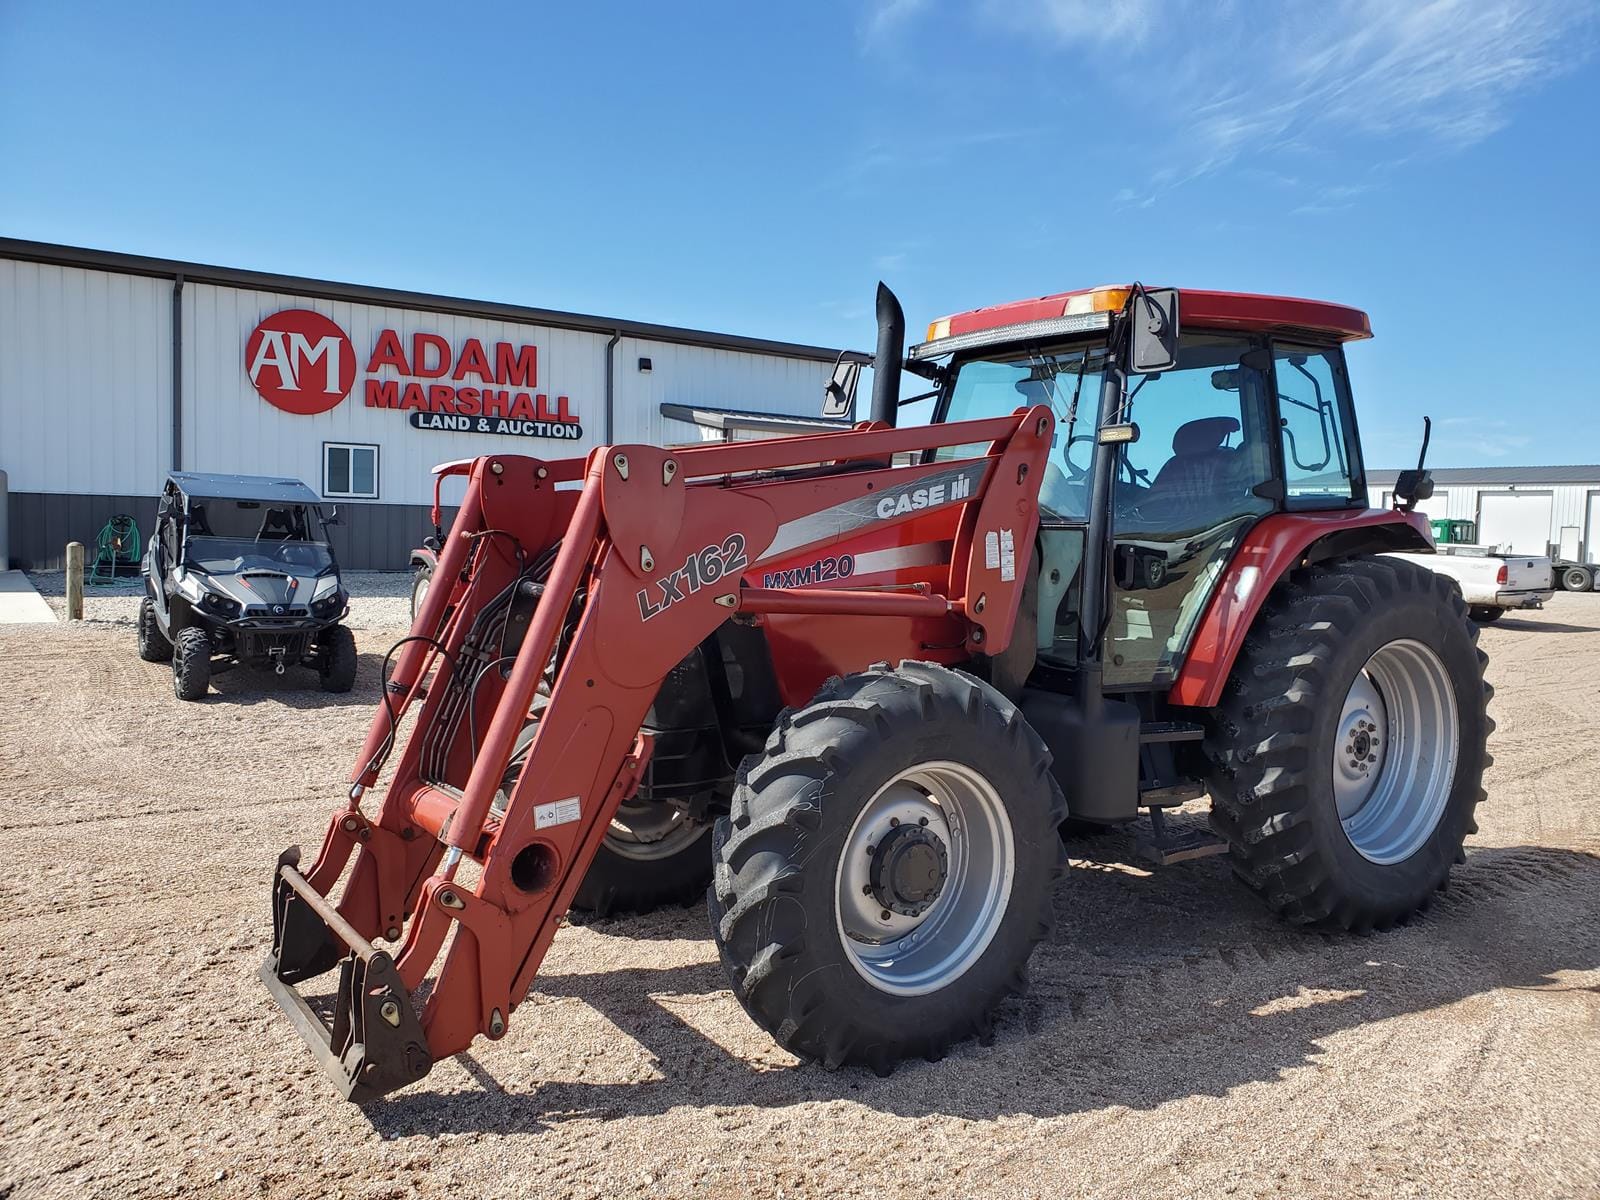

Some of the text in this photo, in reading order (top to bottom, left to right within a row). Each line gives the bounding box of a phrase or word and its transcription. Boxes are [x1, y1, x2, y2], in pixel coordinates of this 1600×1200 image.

[250, 329, 343, 395] AM
[366, 329, 538, 388] ADAM
[364, 379, 580, 424] MARSHALL
[418, 412, 578, 440] LAND & AUCTION
[877, 484, 945, 519] CASE
[636, 532, 748, 622] LX162
[763, 554, 854, 590] MXM120
